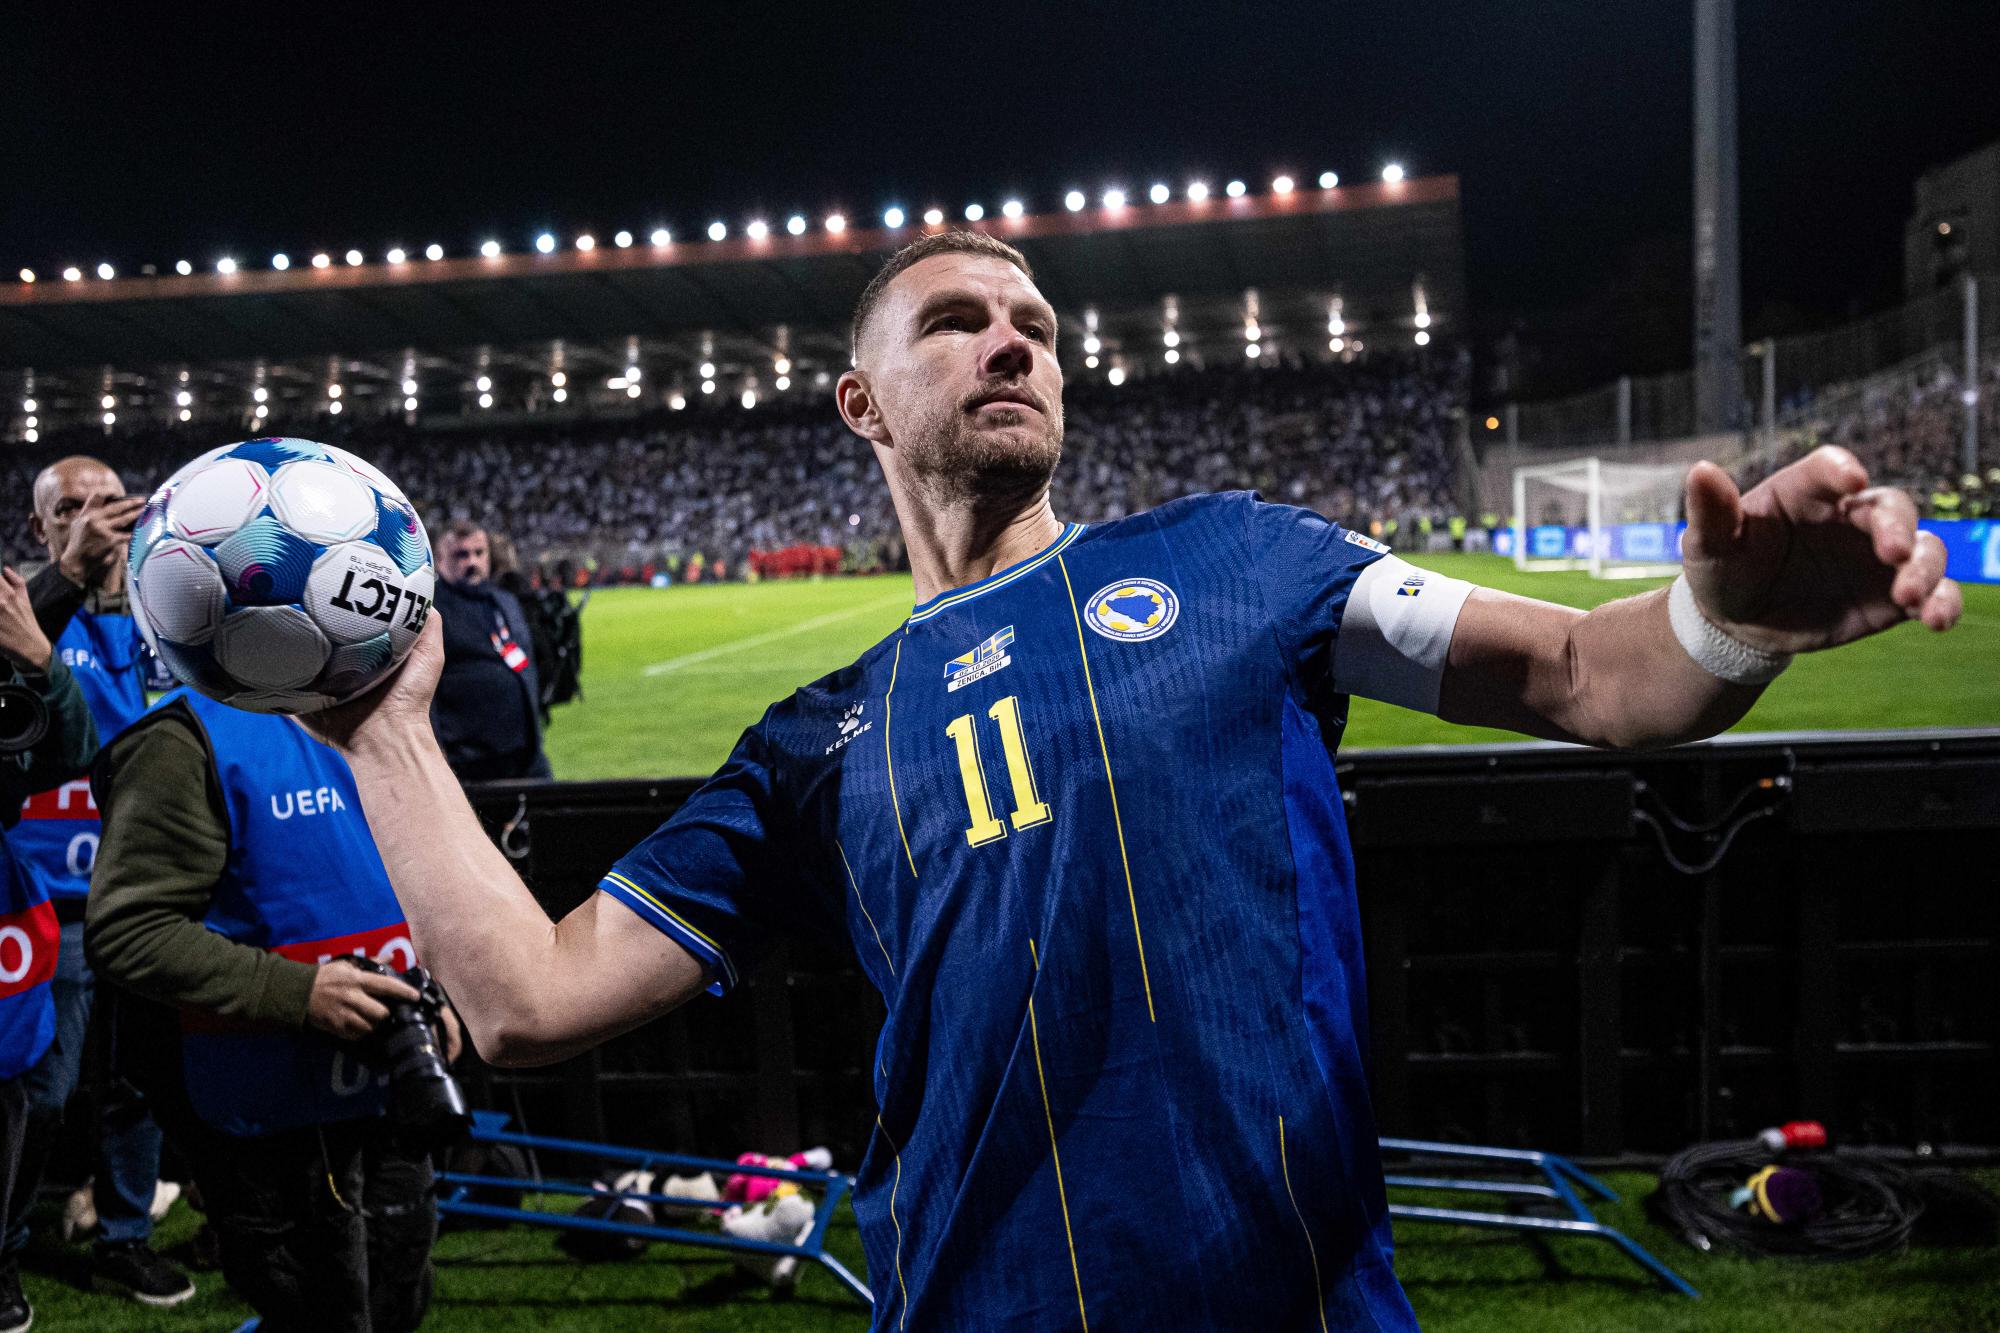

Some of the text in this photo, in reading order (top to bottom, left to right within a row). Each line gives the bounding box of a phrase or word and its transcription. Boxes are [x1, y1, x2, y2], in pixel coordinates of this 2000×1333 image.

[330, 570, 431, 634] SELECT
[61, 647, 101, 670] EFA
[825, 721, 873, 755] KELME
[946, 696, 1053, 848] 11
[271, 785, 346, 820] UEFA
